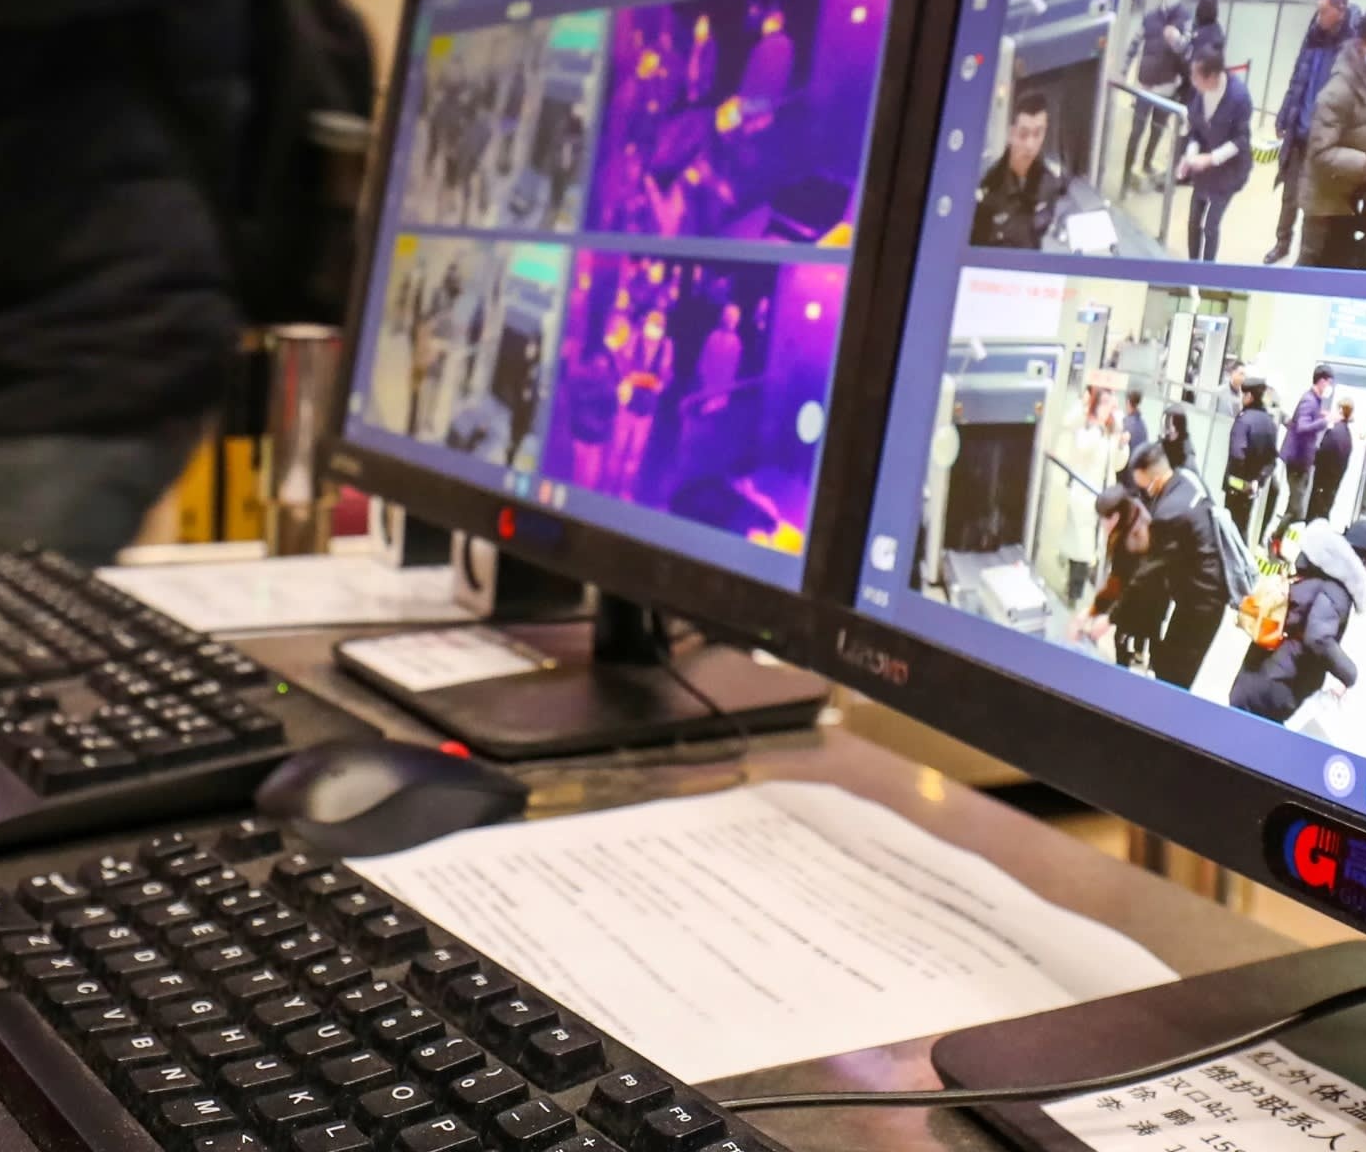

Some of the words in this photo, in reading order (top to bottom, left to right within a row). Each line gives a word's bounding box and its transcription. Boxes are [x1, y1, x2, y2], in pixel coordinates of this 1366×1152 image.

[28, 935, 51, 947] Z
[50, 957, 74, 969] X
[76, 982, 99, 994] C
[103, 1007, 126, 1019] V
[131, 1036, 154, 1049] B
[160, 1067, 187, 1081] N
[193, 1099, 221, 1115] M
[108, 927, 130, 939] S
[133, 950, 156, 962] D
[159, 974, 183, 985] F
[191, 1000, 213, 1014] G
[220, 1028, 245, 1042] H
[255, 1061, 278, 1070] J
[288, 1090, 314, 1105] K
[325, 1124, 346, 1138] L
[191, 923, 215, 936] E
[220, 946, 243, 959] R
[251, 970, 274, 982] T
[283, 996, 306, 1008] Y
[317, 1024, 341, 1038] U
[391, 1086, 415, 1100] O
[431, 1119, 456, 1132] P
[510, 1000, 529, 1012] F7
[551, 1028, 570, 1041] F8
[619, 1073, 638, 1087] F9
[669, 1106, 692, 1122] F10
